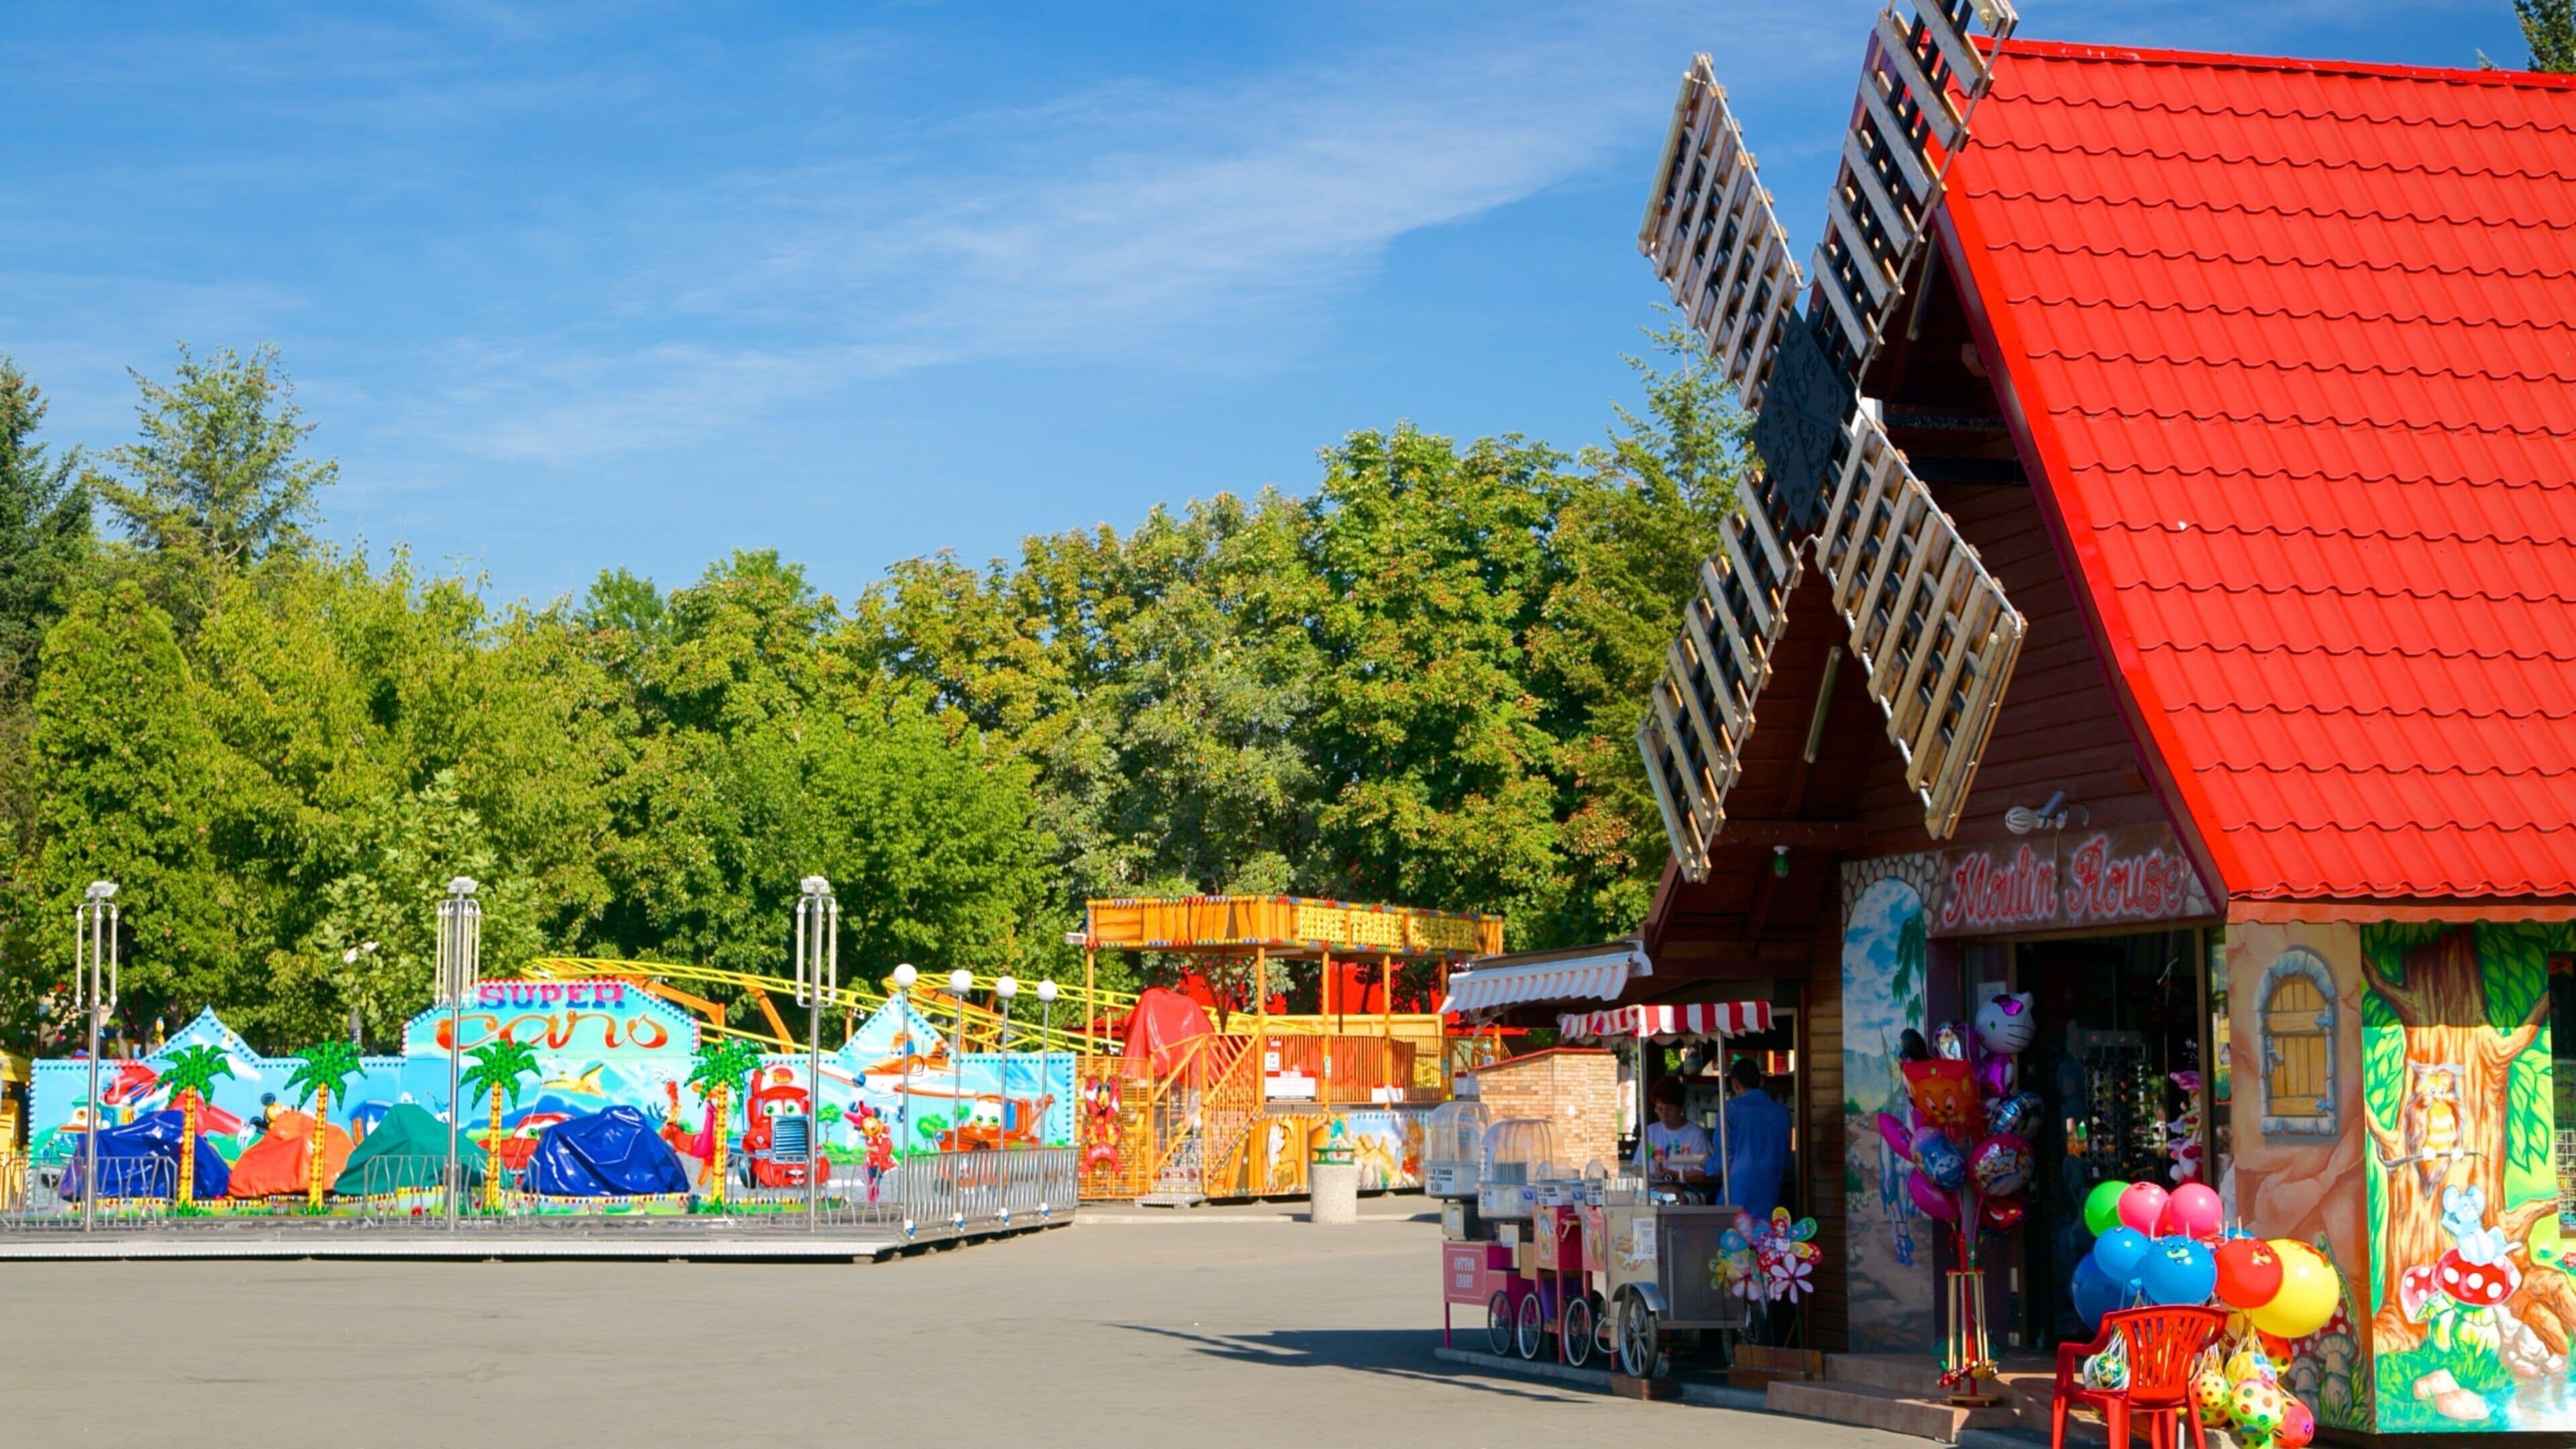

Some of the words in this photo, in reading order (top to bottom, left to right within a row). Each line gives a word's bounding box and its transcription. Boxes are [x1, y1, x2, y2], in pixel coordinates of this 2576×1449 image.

[1945, 843, 2057, 926] Moulin
[2066, 835, 2184, 916] Rouge
[478, 984, 626, 1009] SUPER
